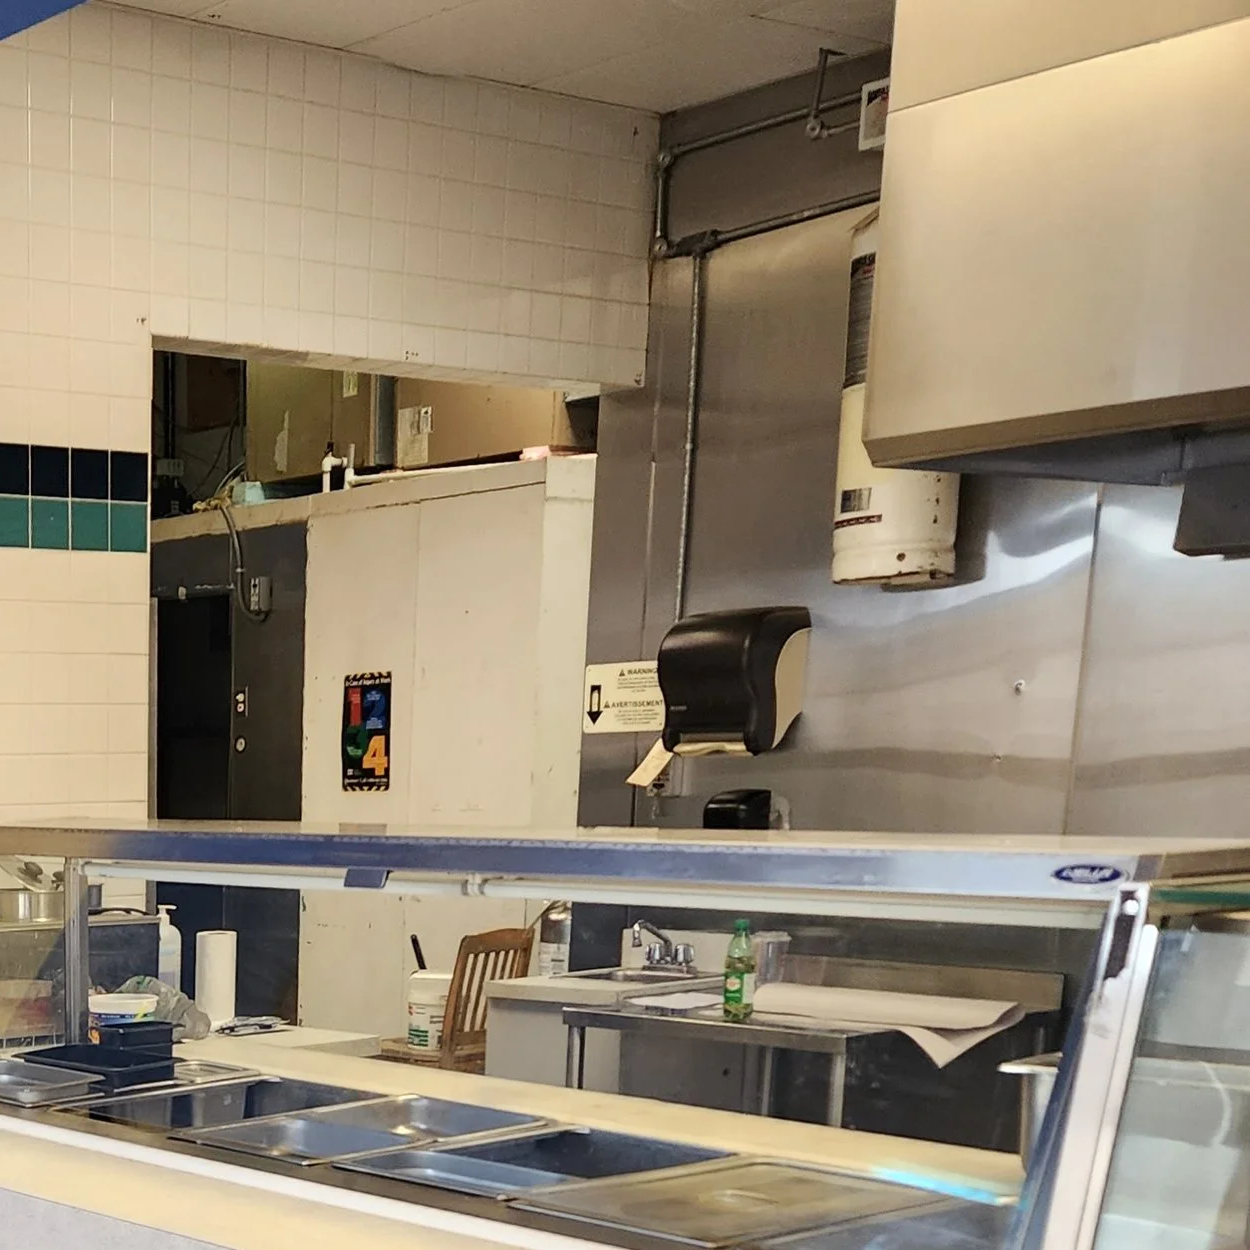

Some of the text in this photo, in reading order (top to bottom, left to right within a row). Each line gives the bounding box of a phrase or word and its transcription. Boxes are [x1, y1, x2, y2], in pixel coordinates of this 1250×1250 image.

[348, 687, 386, 730] 1 2
[611, 700, 663, 708] AVERTISSEMENT
[362, 735, 388, 776] 4
